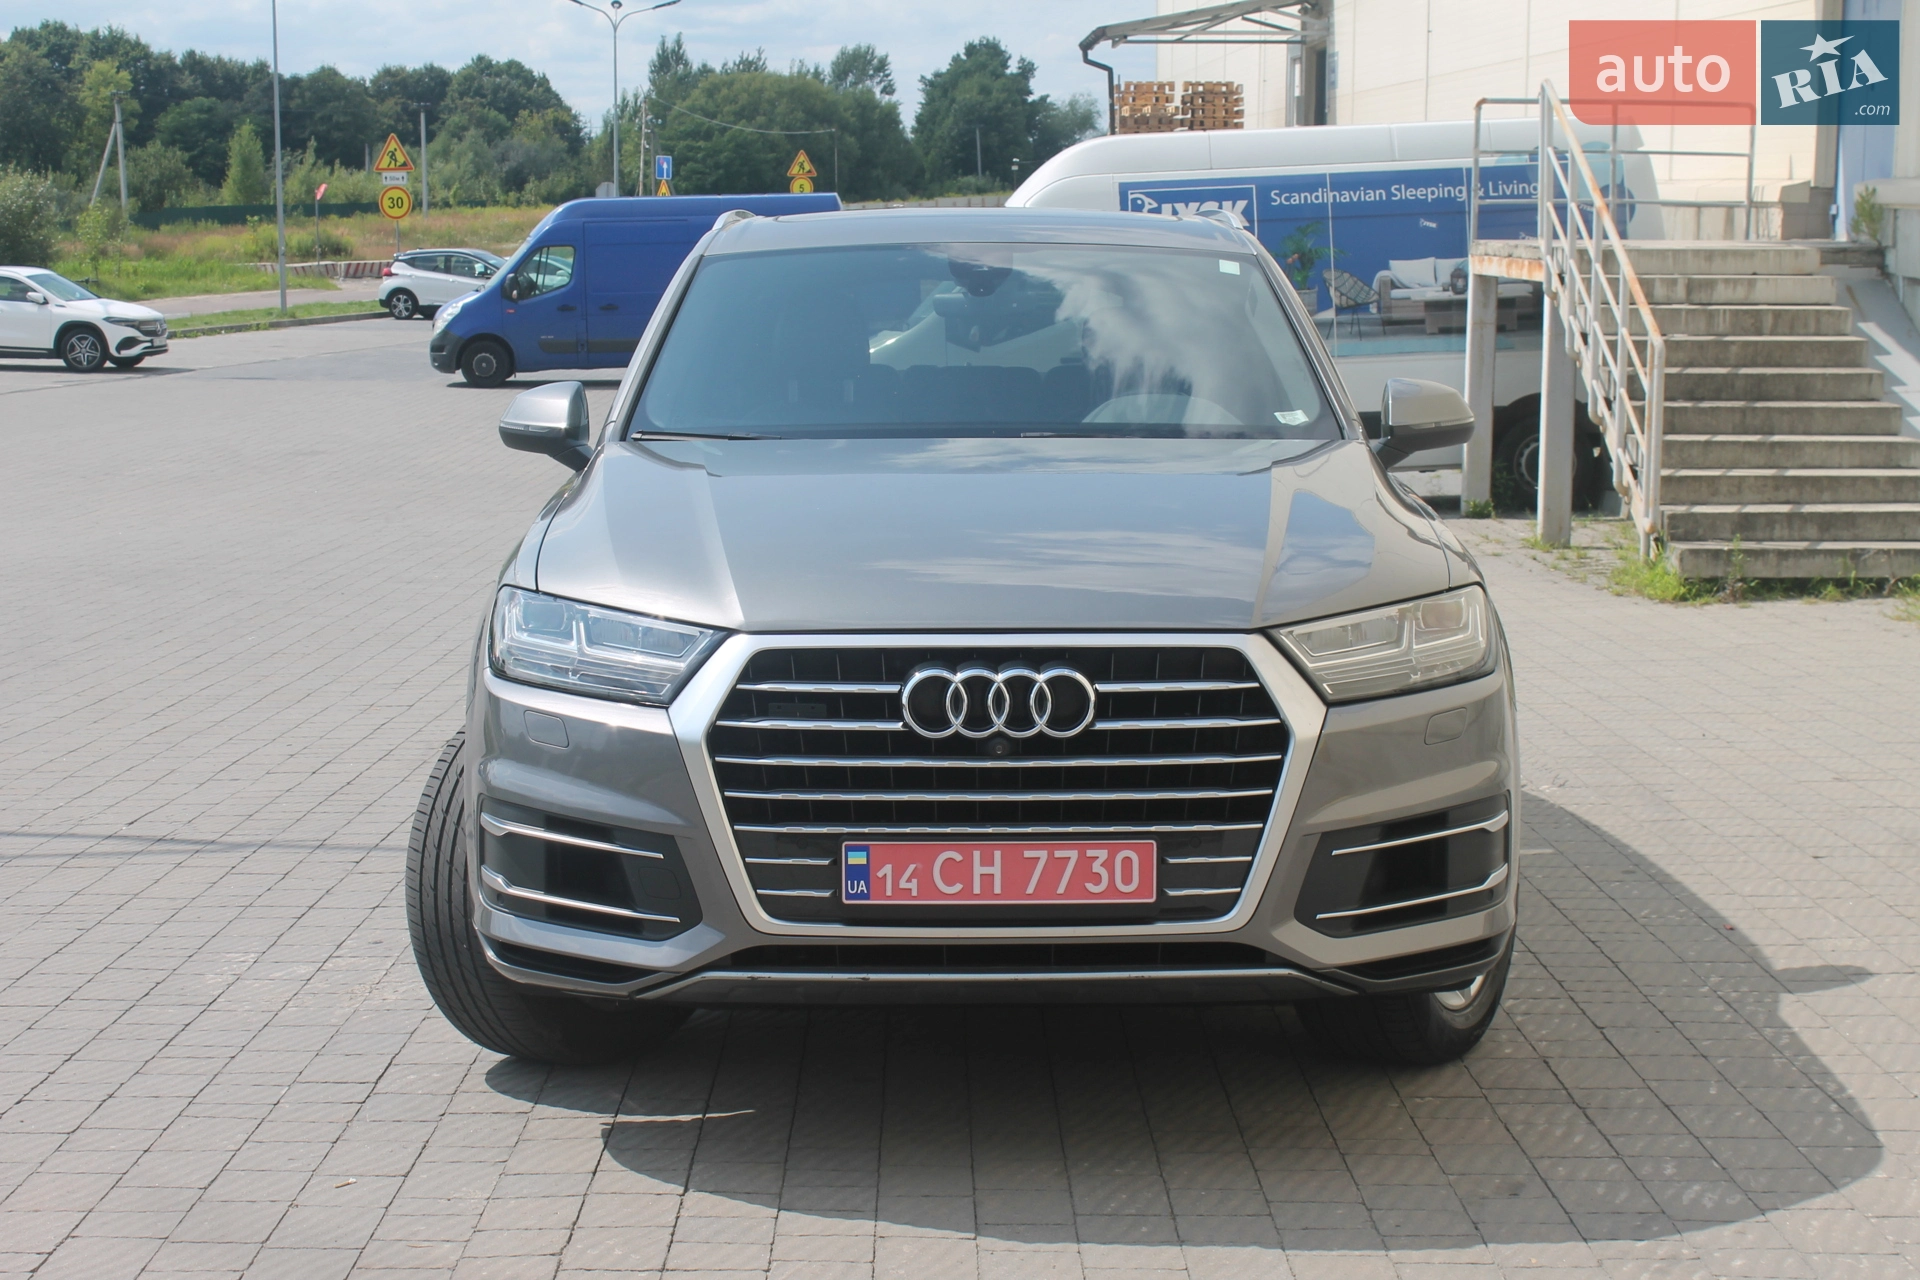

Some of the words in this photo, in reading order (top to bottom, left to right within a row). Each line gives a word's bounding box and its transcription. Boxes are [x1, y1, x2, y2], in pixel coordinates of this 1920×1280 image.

[388, 197, 404, 209] 30
[1270, 187, 1386, 206] Scandinavian
[1391, 183, 1466, 203] Sleeping
[1489, 180, 1539, 198] Living
[876, 863, 919, 897] 14
[932, 850, 1002, 895] CH
[1022, 849, 1140, 895] 7730
[847, 880, 868, 894] UA
